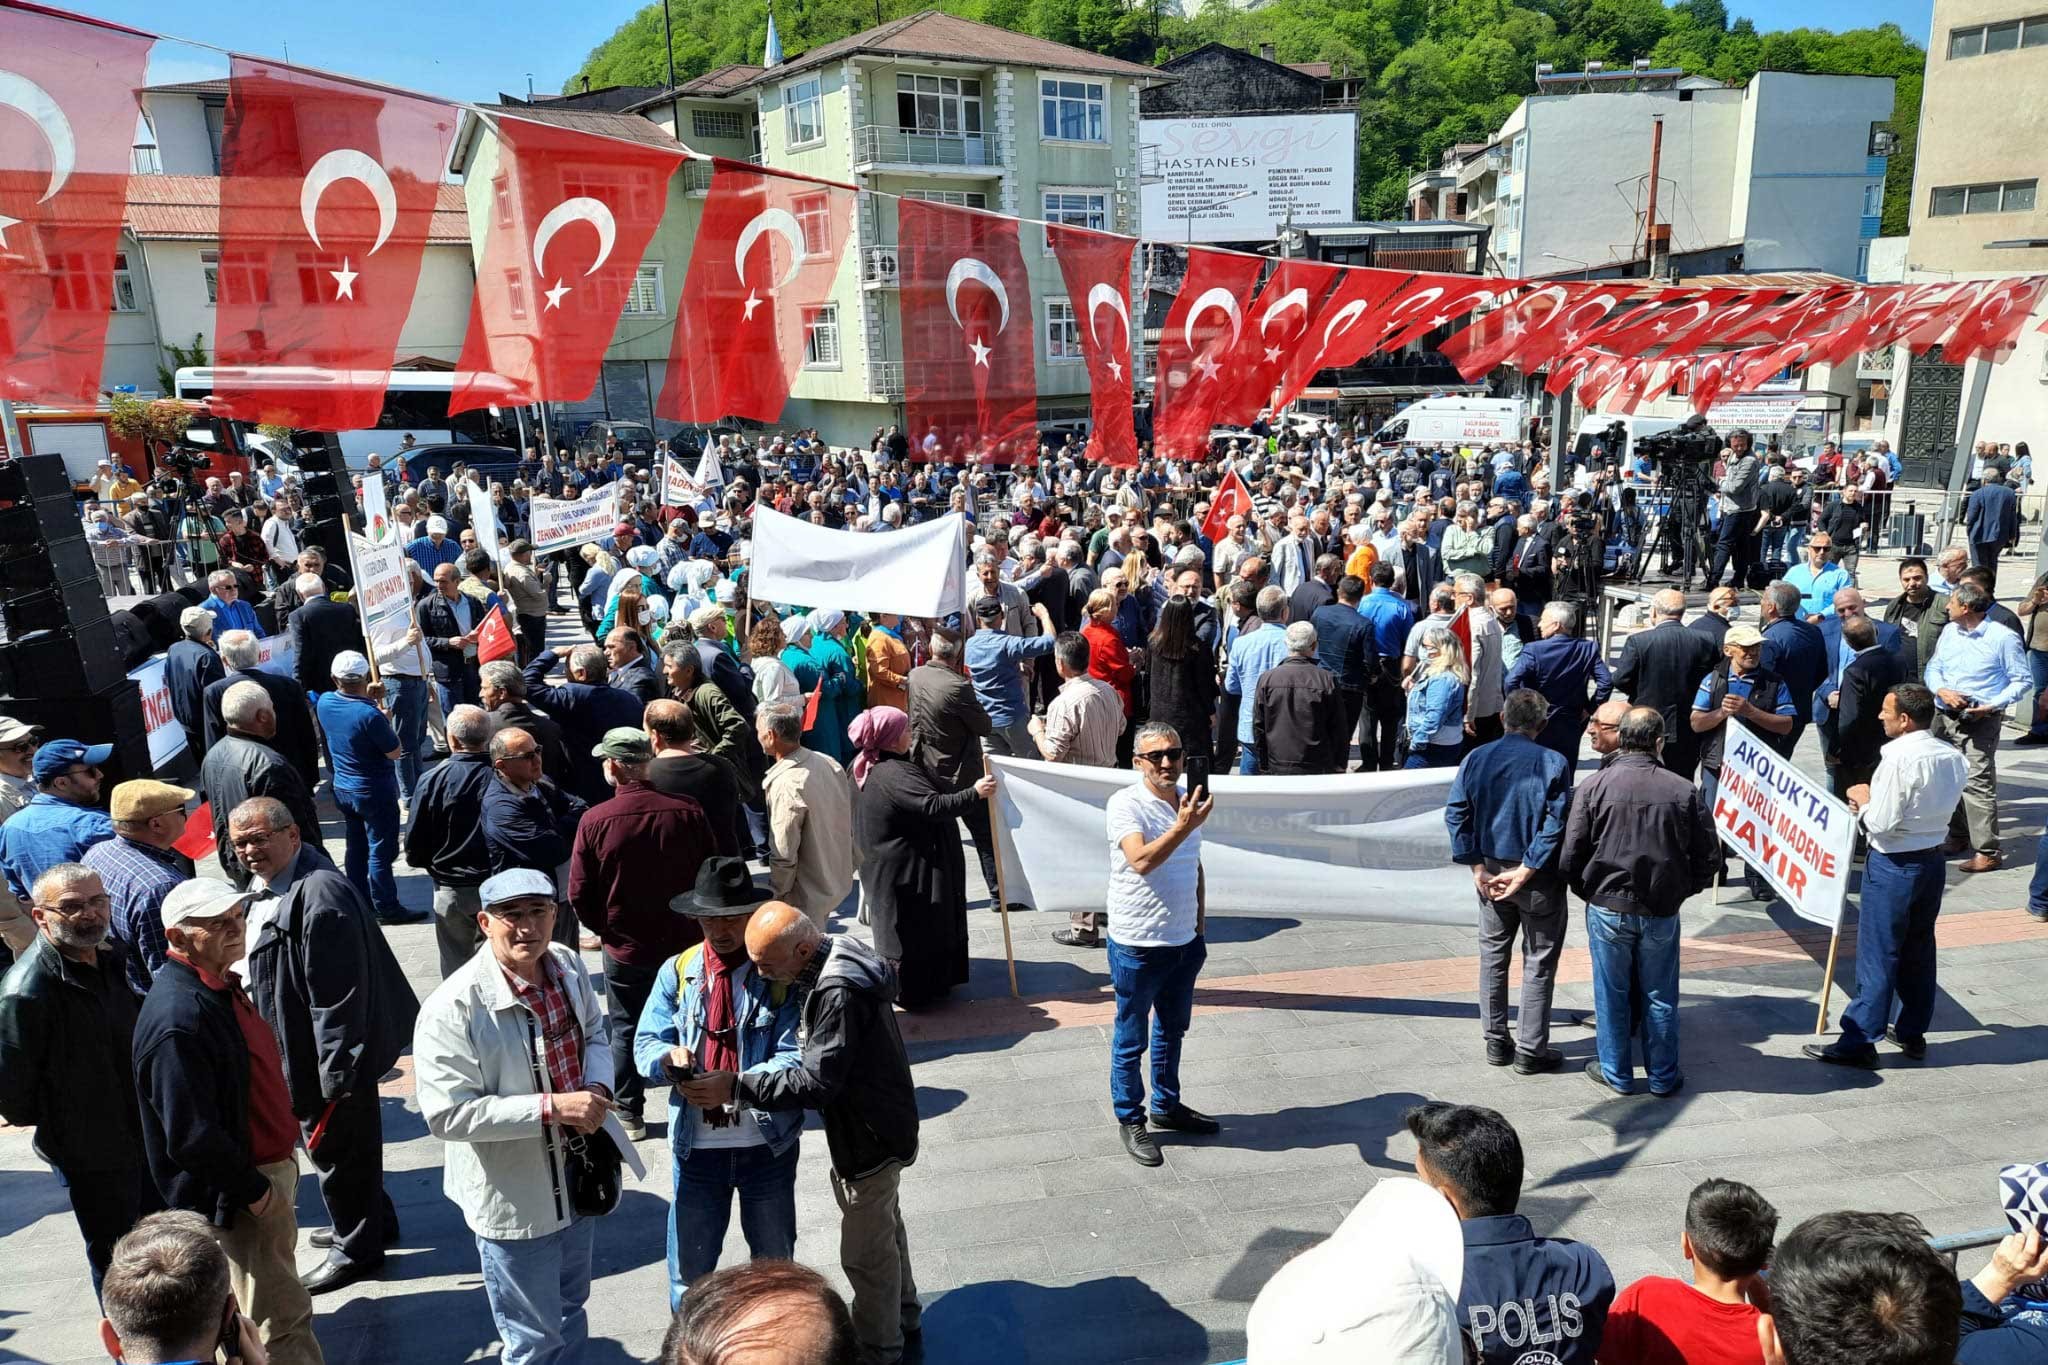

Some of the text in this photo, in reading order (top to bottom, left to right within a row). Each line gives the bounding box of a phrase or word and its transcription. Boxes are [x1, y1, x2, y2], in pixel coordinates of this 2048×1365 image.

[1159, 120, 1338, 166] Sevgi
[537, 524, 564, 542] ZEHİRLİ
[563, 520, 591, 535] MADENE
[1733, 741, 1830, 832] AKOLUK'TA
[1714, 797, 1807, 900] HAYIR
[1776, 813, 1836, 878] MADENE
